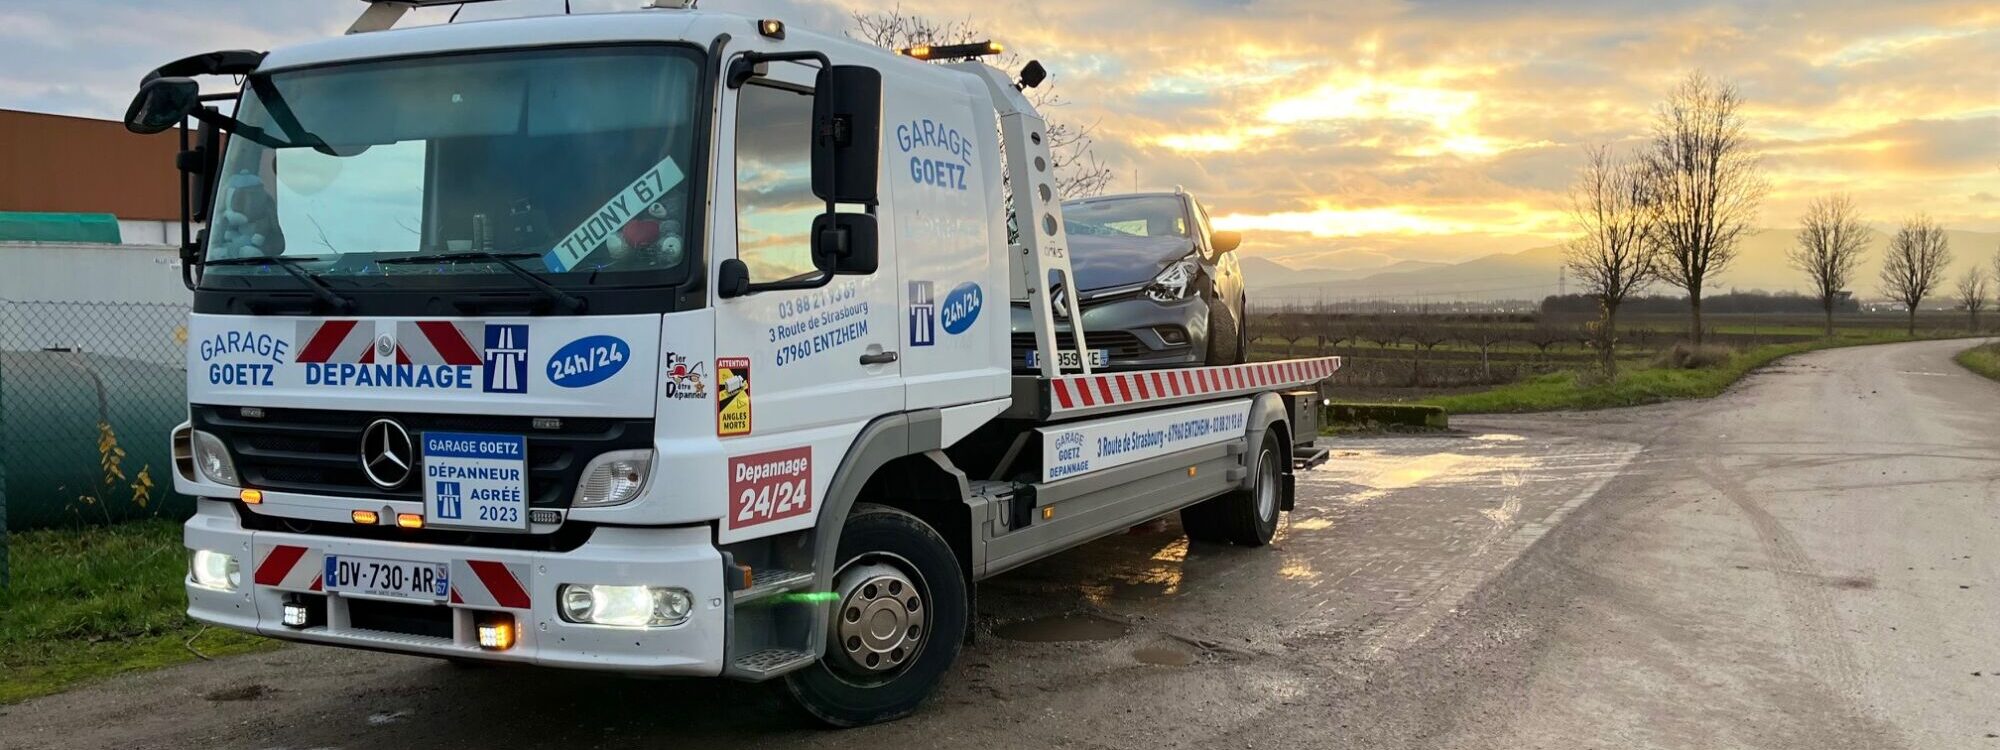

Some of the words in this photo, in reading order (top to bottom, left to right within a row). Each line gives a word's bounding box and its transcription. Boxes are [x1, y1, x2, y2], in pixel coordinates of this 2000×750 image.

[897, 119, 973, 167] GARAGE
[910, 156, 967, 190] GOETZ
[561, 195, 631, 260] THONY
[633, 169, 663, 204] 67
[779, 300, 794, 319] 03
[796, 296, 810, 314] 88
[943, 290, 980, 328] 24h/24
[769, 328, 776, 343] 3
[778, 321, 806, 340] Route
[808, 315, 820, 330] de
[821, 301, 869, 326] Strasbourg
[201, 331, 289, 364] GARAGE
[776, 340, 811, 367] 67960
[813, 319, 868, 353] ENTZHEIM
[209, 363, 274, 386] GOETZ
[552, 344, 623, 382] 24h/24
[723, 412, 747, 421] ANGLES
[723, 421, 746, 430] MORTS
[429, 439, 477, 452] GARAGE
[479, 441, 518, 454] GOETZ
[1055, 432, 1085, 450] GARAGE
[1097, 437, 1102, 457] 3
[1103, 433, 1121, 456] Route
[1123, 433, 1131, 452] de
[1131, 429, 1164, 450] Strasbourg
[1058, 447, 1080, 461] GOETZ
[428, 462, 520, 480] DÉPANNEUR
[736, 457, 808, 484] Depannage
[1050, 460, 1089, 478] DEPANNAGE
[470, 486, 520, 502] AGRÉÉ
[737, 479, 807, 521] 24/24
[479, 505, 518, 522] 2023
[339, 561, 434, 593] DV-730-AR
[437, 582, 446, 593] 67
